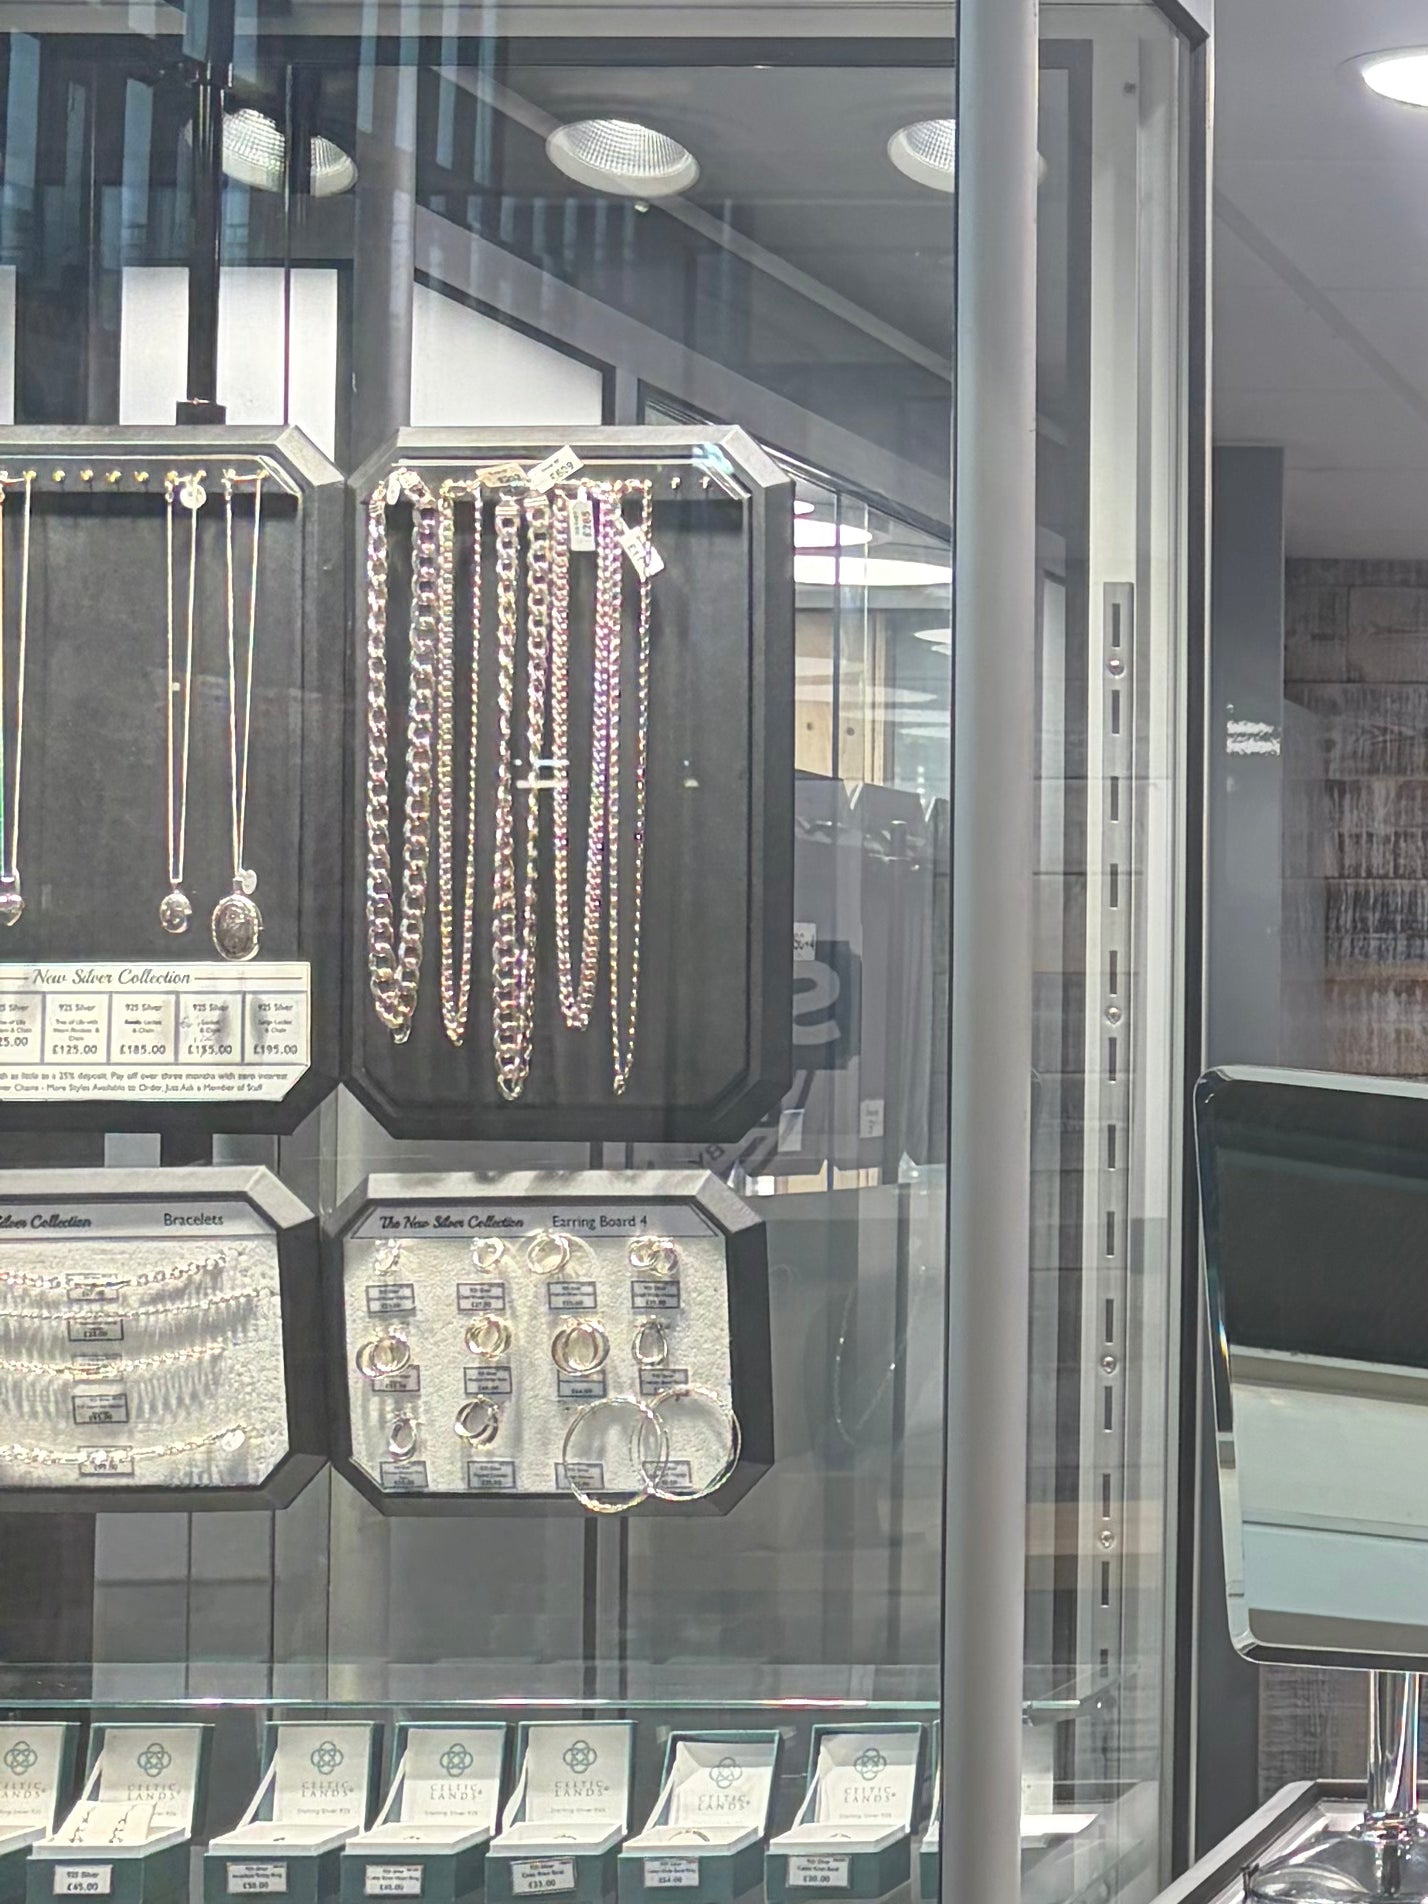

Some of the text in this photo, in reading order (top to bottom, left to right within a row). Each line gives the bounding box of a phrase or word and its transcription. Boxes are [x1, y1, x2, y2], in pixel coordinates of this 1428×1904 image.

[33, 968, 191, 985] New Silver Collection
[31, 1215, 92, 1228] Collection
[163, 1213, 224, 1226] Bracelets
[468, 1216, 524, 1228] Collection
[553, 1215, 596, 1231] Earring
[600, 1215, 635, 1228] Board
[639, 1215, 647, 1227] 4
